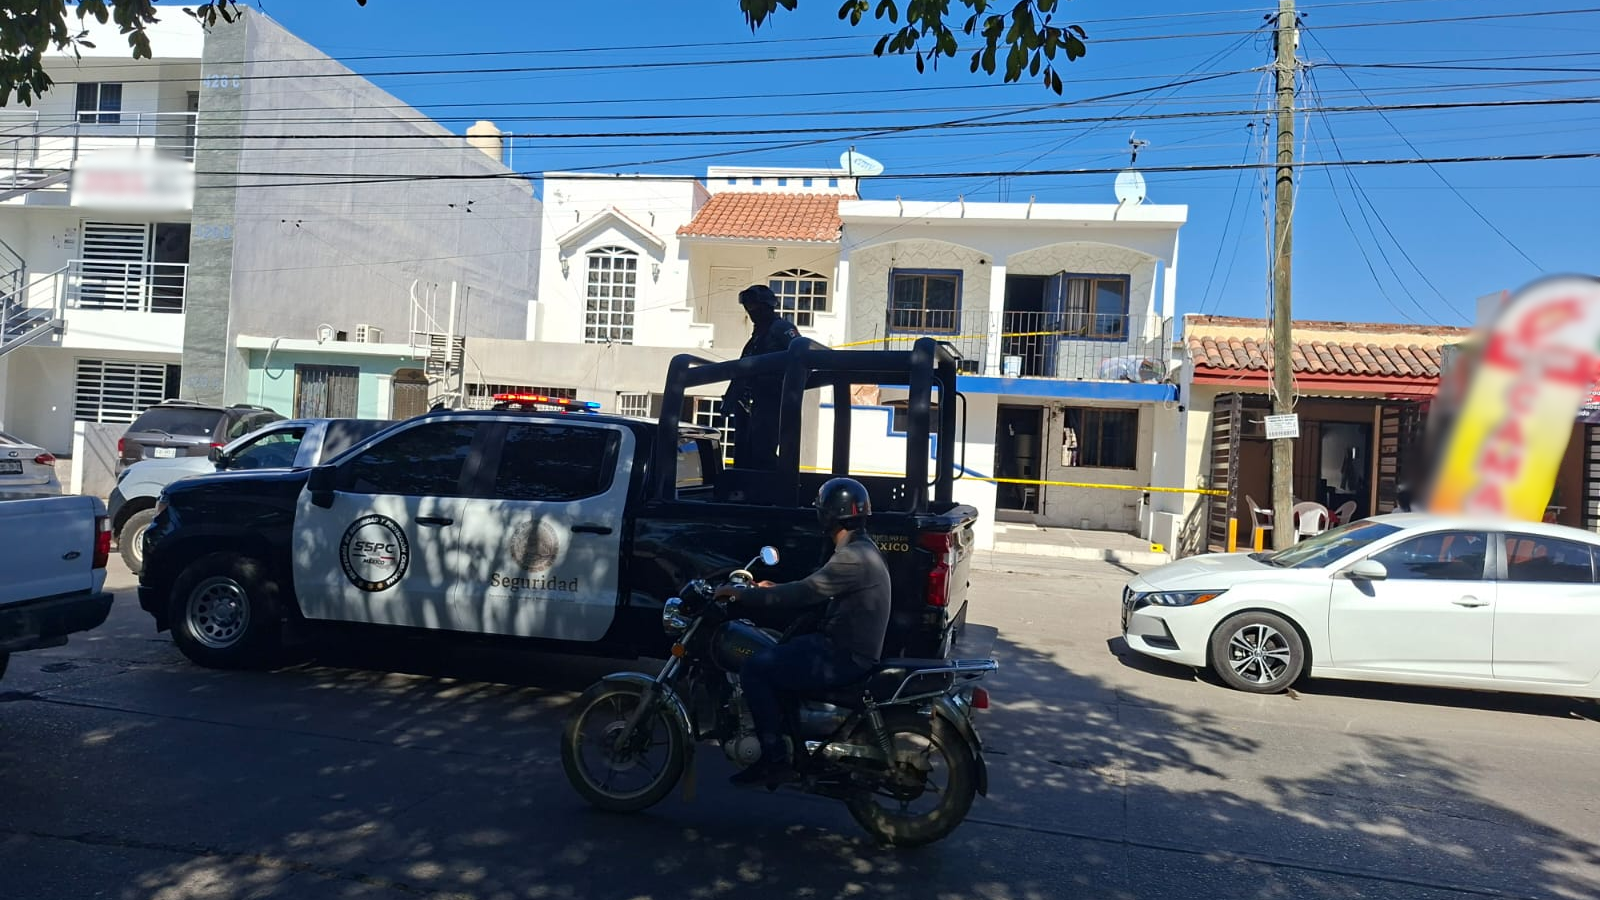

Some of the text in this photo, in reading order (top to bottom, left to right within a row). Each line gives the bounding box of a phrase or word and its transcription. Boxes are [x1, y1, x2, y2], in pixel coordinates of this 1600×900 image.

[353, 541, 396, 554] SSPC
[879, 542, 909, 552] XICO
[490, 572, 579, 593] Seguridad
